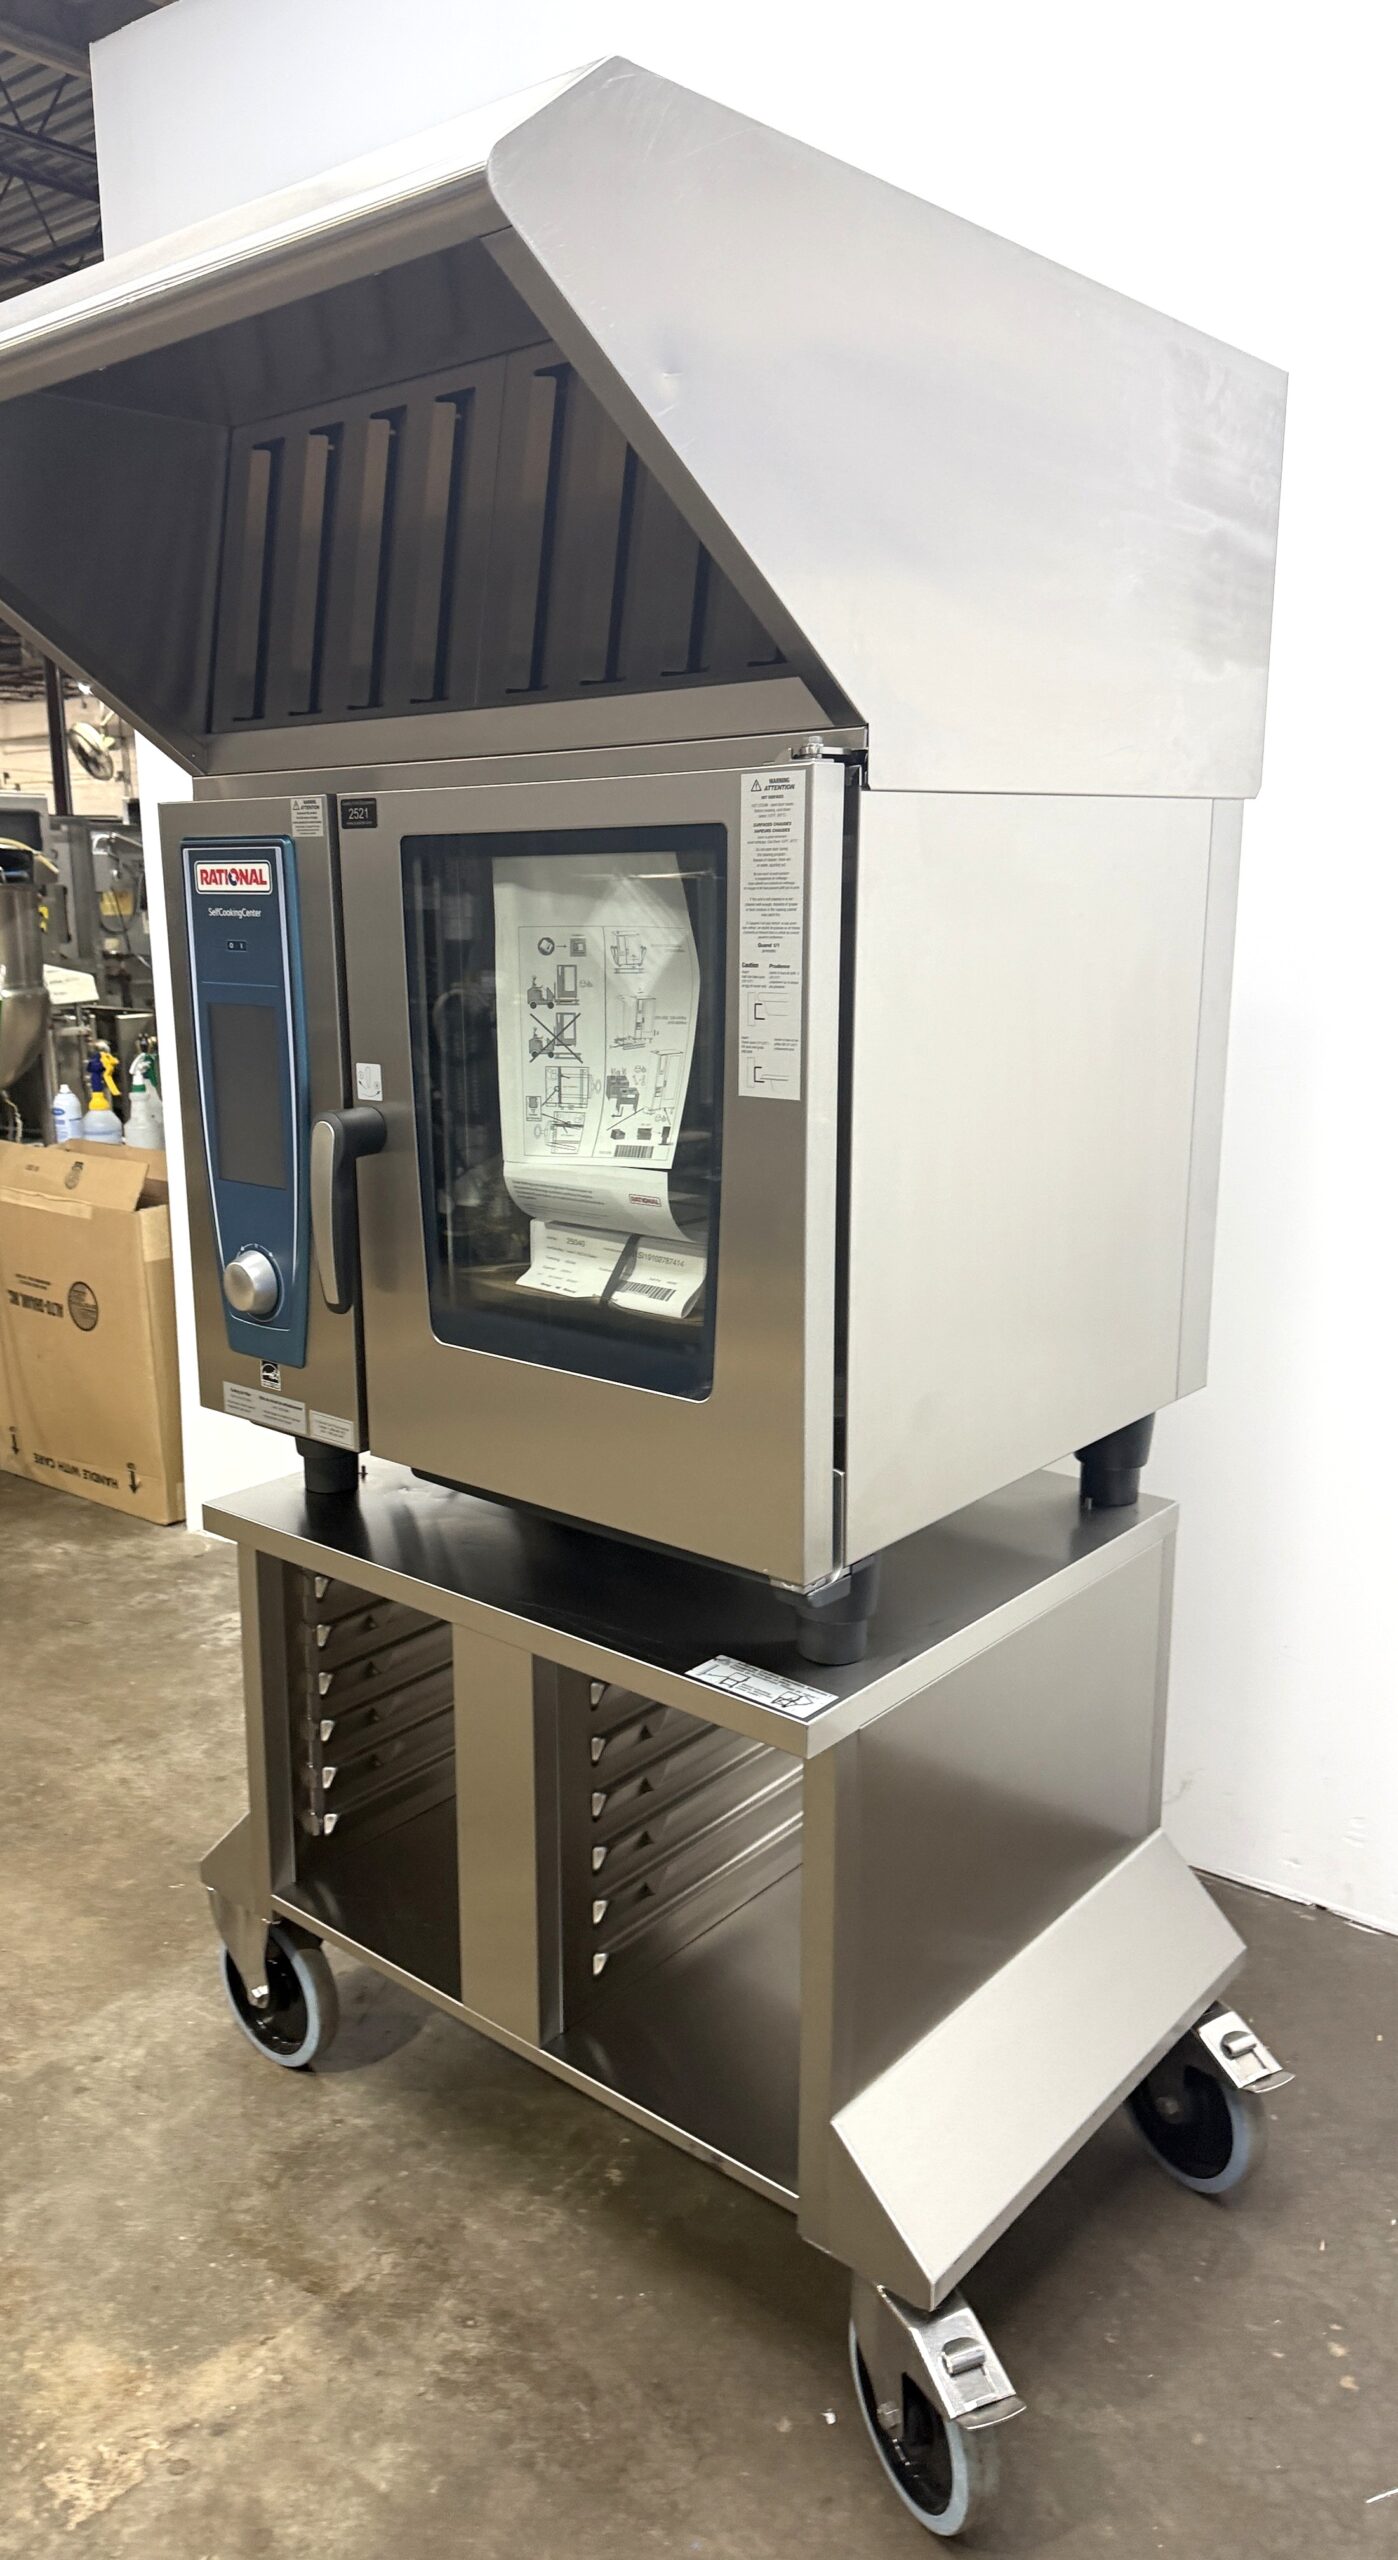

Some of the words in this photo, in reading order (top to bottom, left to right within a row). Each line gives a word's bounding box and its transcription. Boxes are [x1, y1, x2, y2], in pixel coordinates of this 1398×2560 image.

[348, 807, 369, 820] 2521
[200, 868, 268, 886] RATIONAL
[208, 907, 262, 919] SelfCookingCenter
[631, 1196, 658, 1205] RATIONAL
